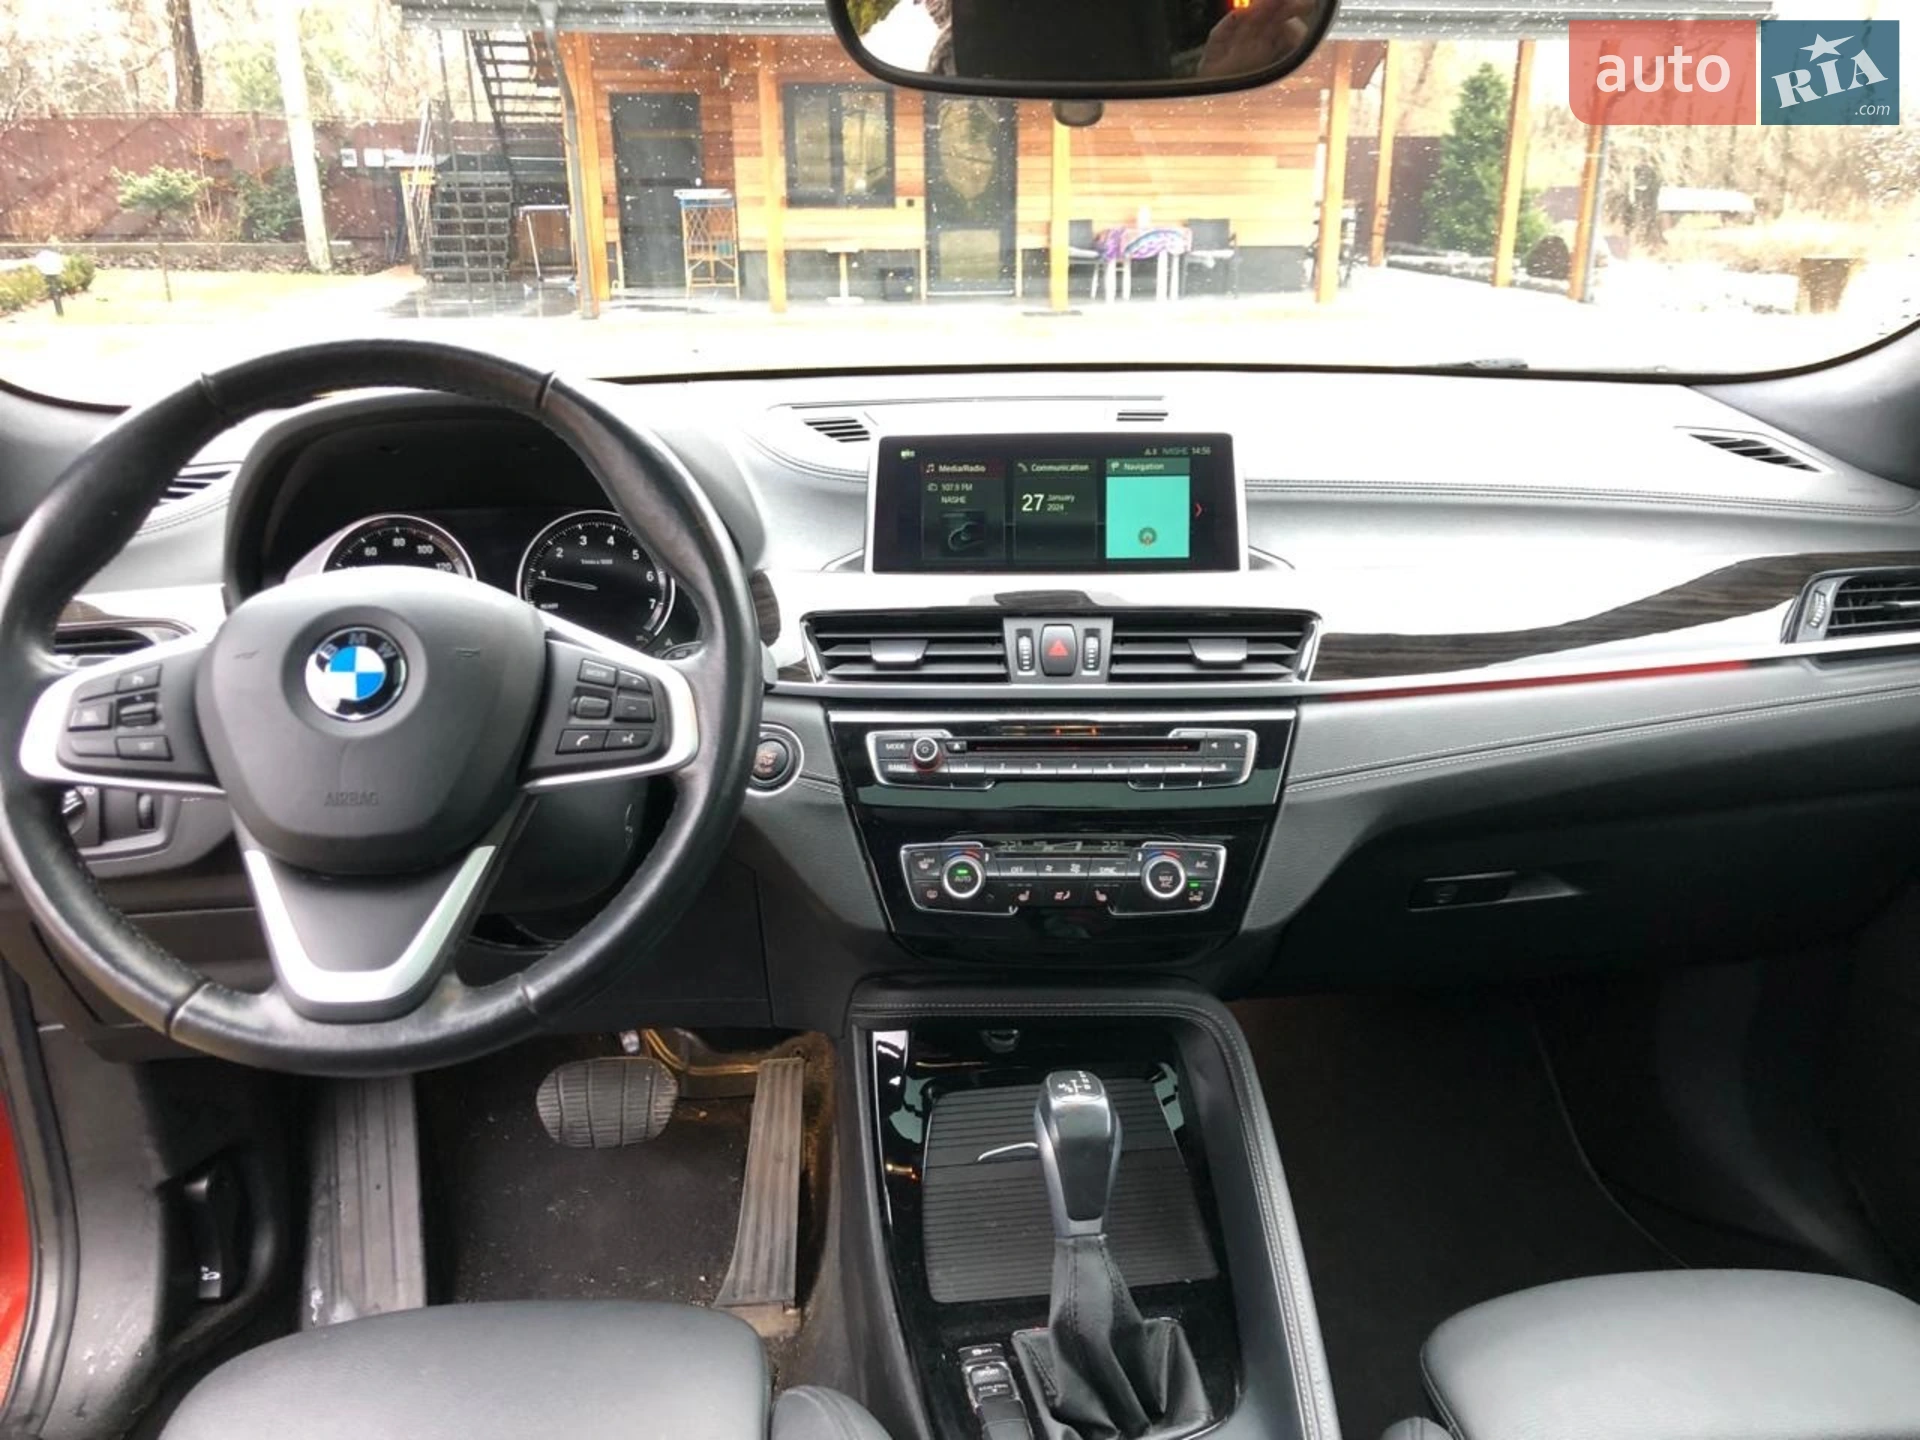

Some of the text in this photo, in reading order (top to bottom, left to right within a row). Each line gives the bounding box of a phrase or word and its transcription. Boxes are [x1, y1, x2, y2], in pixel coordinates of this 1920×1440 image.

[1031, 463, 1090, 472] Communication
[1123, 463, 1165, 472] Navigation
[1022, 493, 1045, 512] 27
[392, 538, 406, 547] 80
[579, 535, 588, 546] 3
[606, 535, 615, 546] 4
[364, 546, 378, 556] 60
[417, 545, 435, 555] 100
[555, 547, 564, 558] 2
[632, 549, 640, 560] 5
[646, 571, 654, 582] 6
[649, 598, 657, 610] 7
[324, 791, 379, 807] AIRBAG
